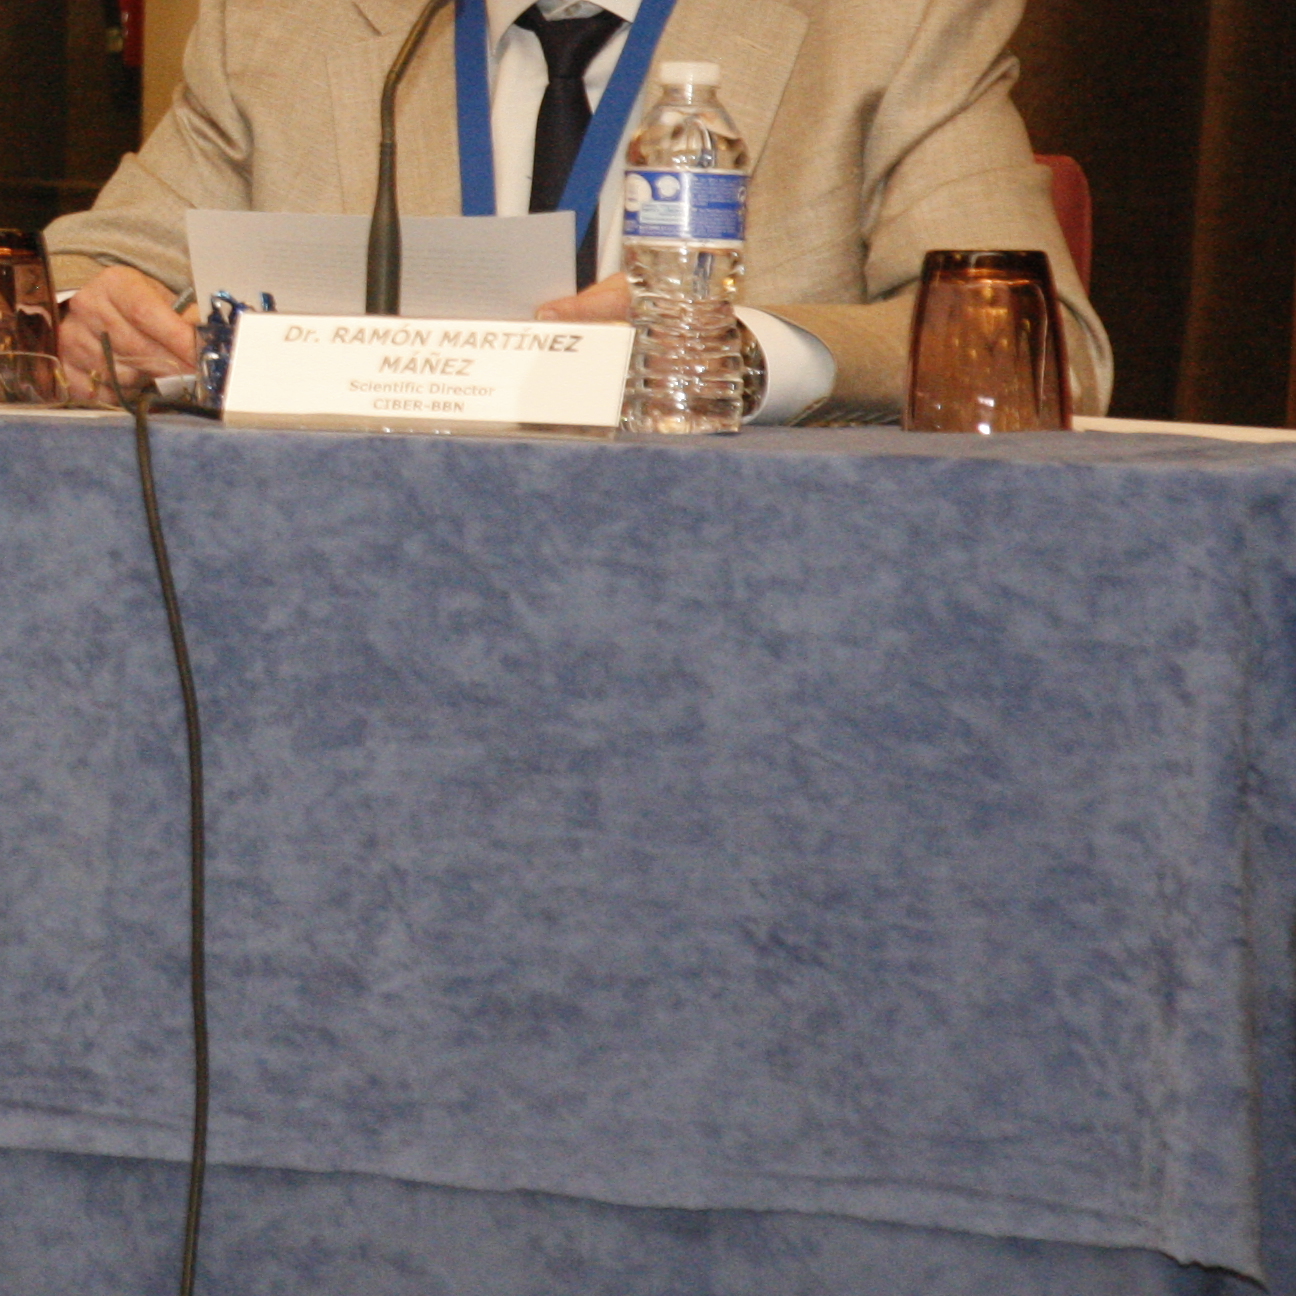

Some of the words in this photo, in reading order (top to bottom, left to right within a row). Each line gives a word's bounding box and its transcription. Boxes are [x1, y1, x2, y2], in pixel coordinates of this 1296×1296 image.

[284, 325, 320, 343] Dr.
[331, 323, 433, 347] RAMÓN
[439, 327, 584, 353] MARTÍNEZ
[377, 349, 474, 376] MÁÑEZ
[349, 380, 424, 395] Scientific
[428, 383, 495, 397] Director
[372, 398, 465, 413] CIBER-BBN
